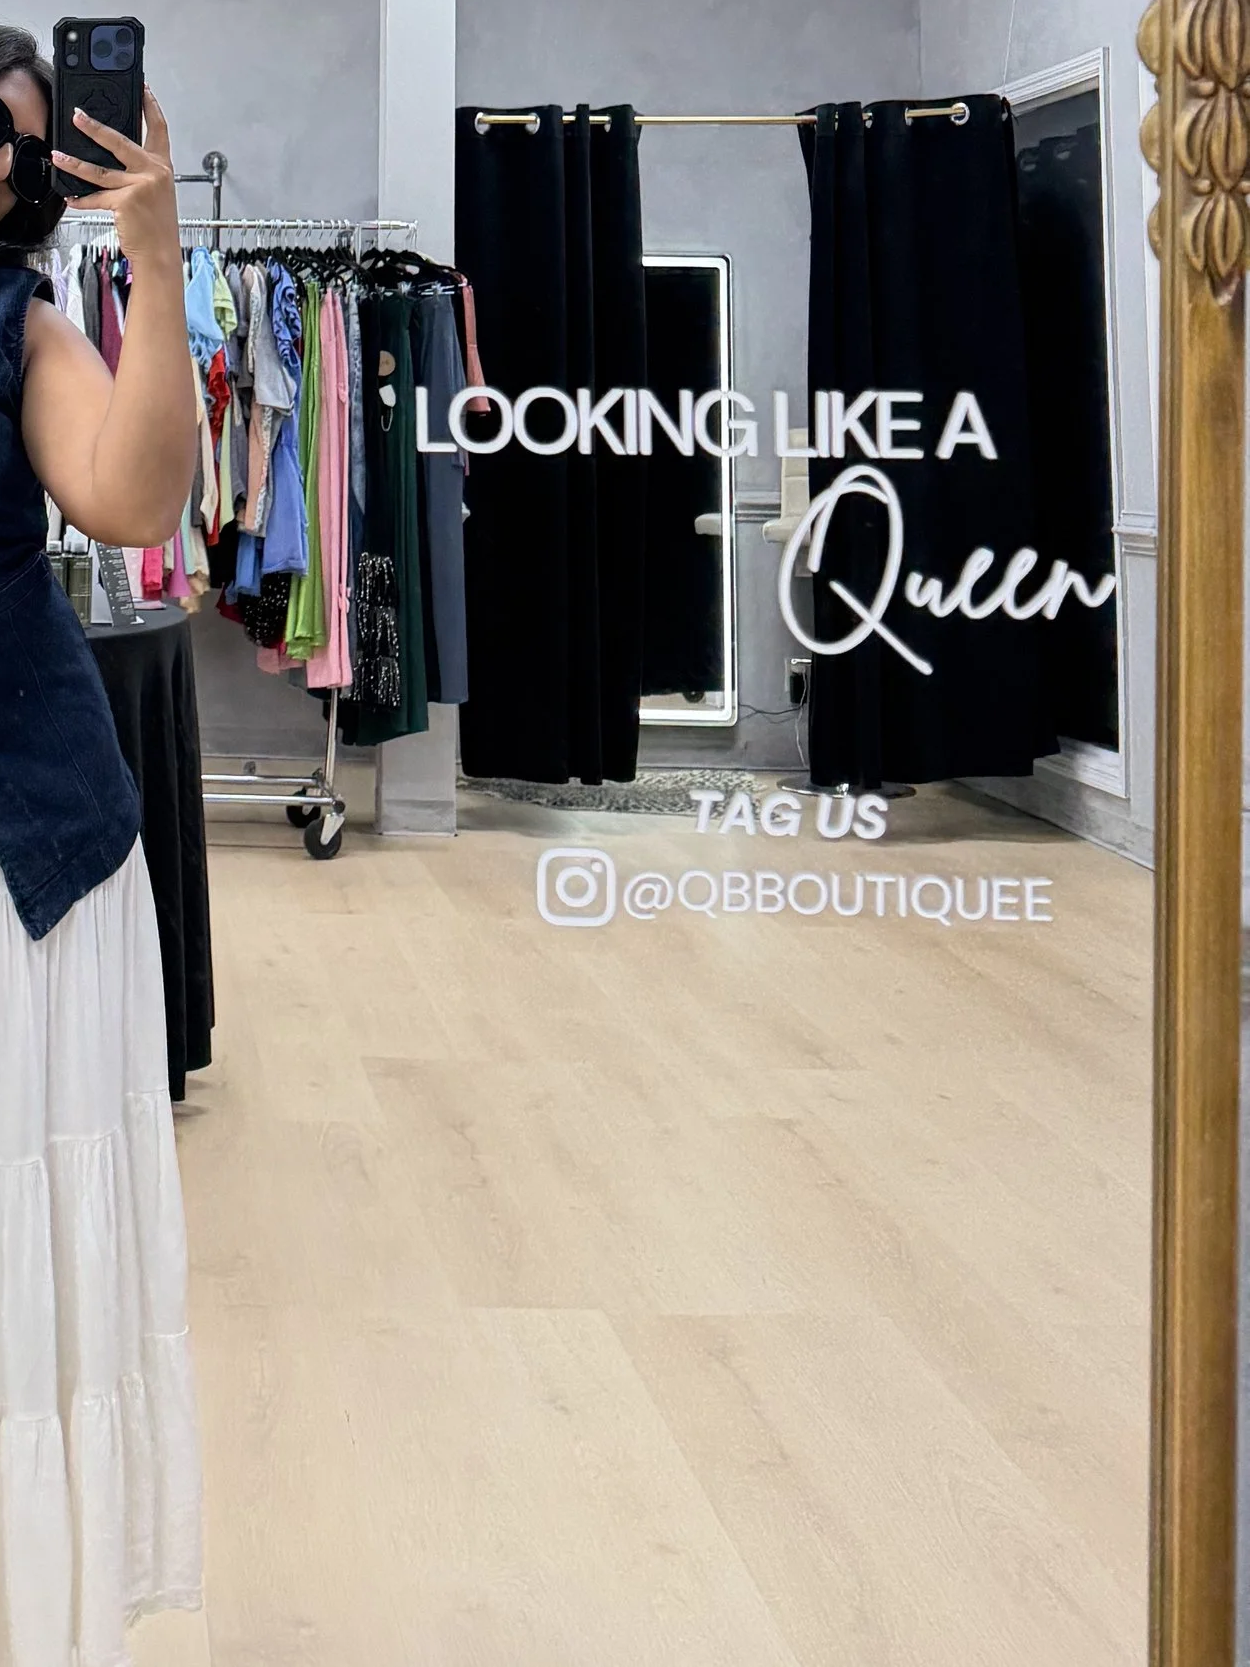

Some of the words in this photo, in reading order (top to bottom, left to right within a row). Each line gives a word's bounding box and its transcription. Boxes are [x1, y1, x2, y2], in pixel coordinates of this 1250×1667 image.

[414, 386, 754, 457] LOOKING
[774, 389, 924, 460] LIKE
[937, 392, 998, 460] A
[780, 465, 1118, 676] Queen
[692, 791, 803, 838] TAG
[817, 794, 889, 841] US
[623, 869, 1055, 926] @QBBOUTIQUEE
